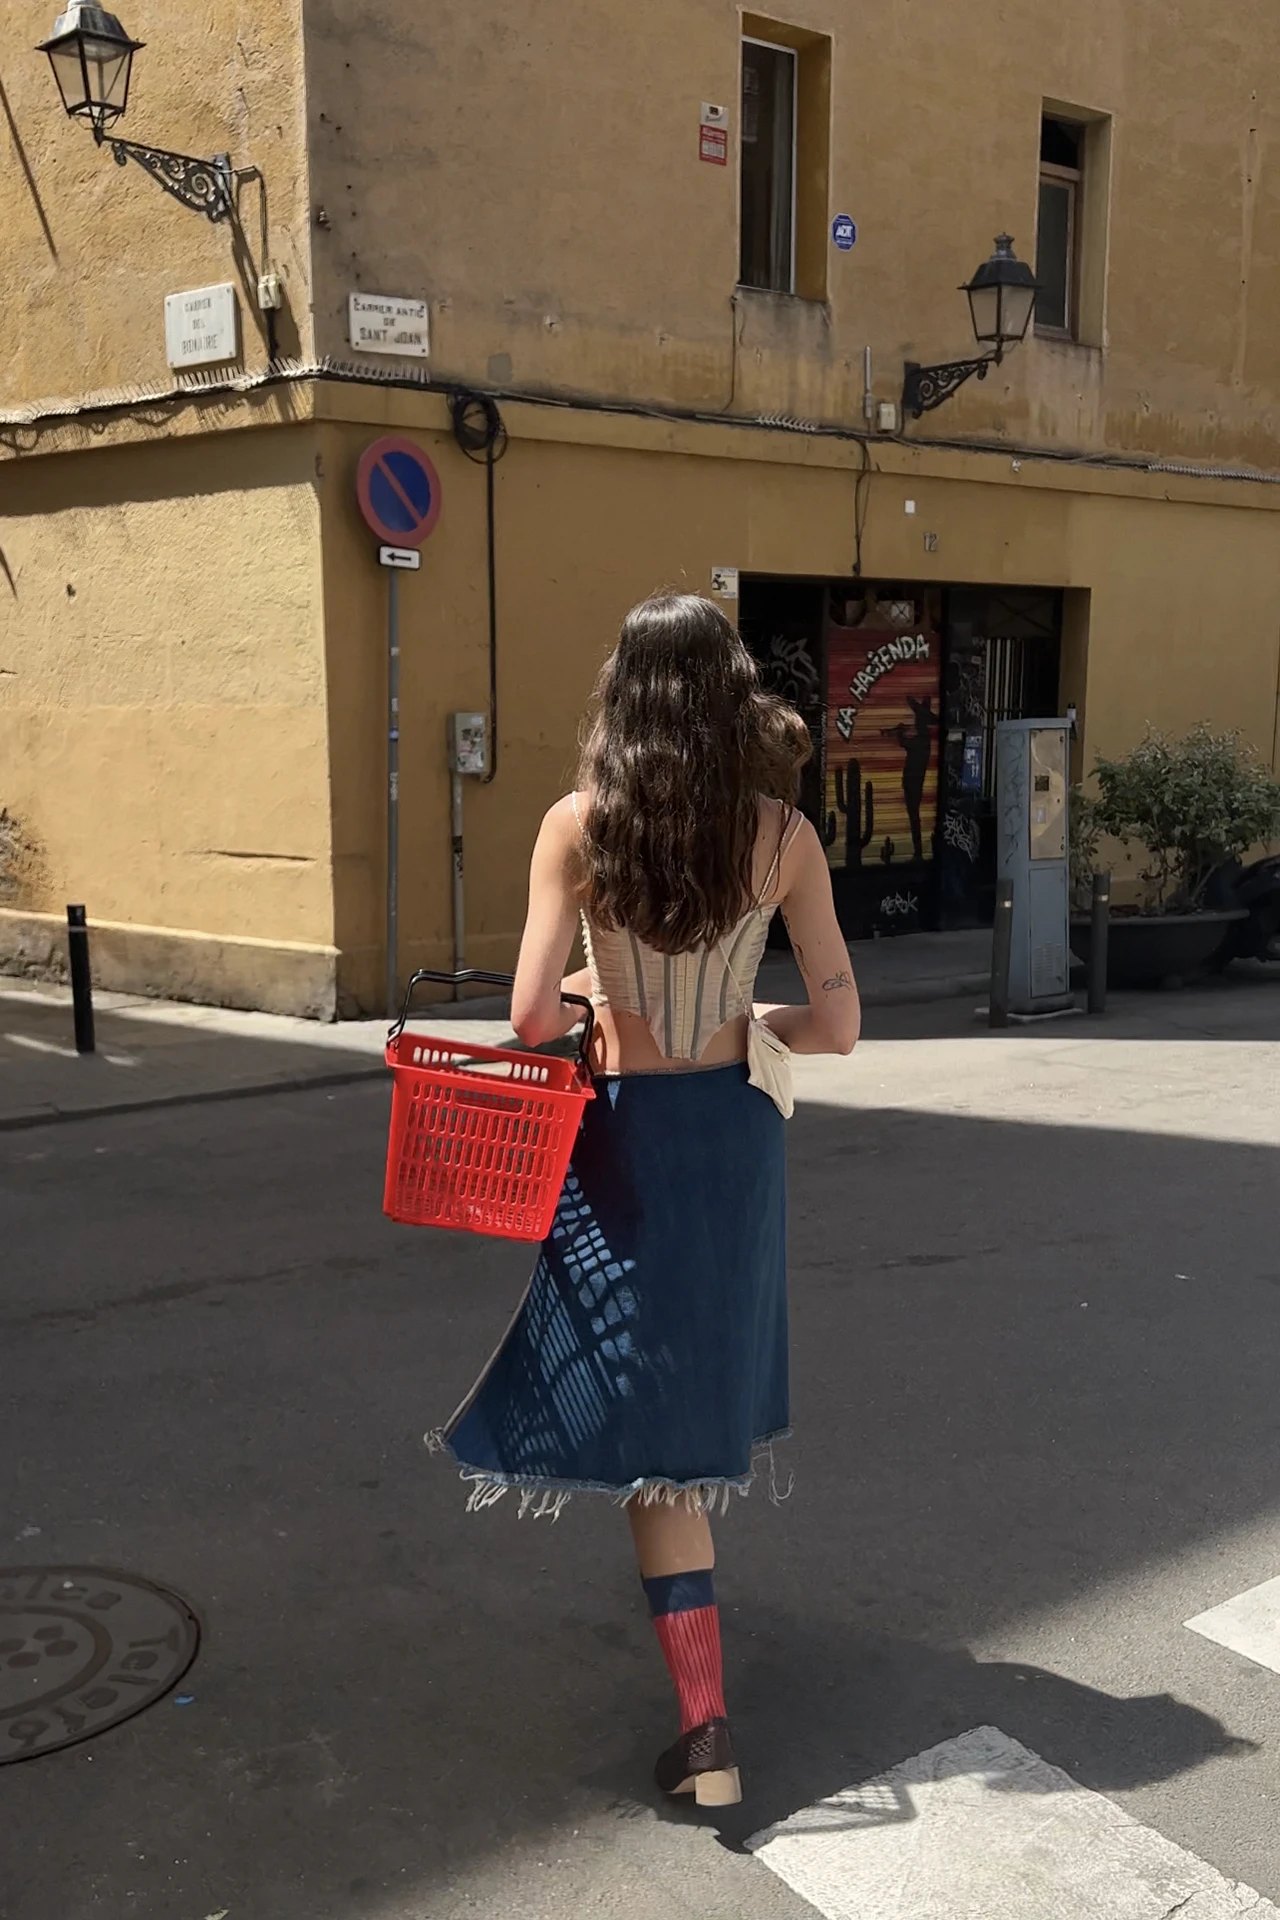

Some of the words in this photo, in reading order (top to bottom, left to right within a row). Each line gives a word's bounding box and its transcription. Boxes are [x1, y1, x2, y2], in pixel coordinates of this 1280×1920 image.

[836, 225, 853, 237] ADT
[360, 327, 388, 342] SANT
[394, 331, 421, 345] JOAN
[923, 531, 939, 552] 12
[836, 706, 856, 739] LA
[849, 633, 930, 701] HACIENDA
